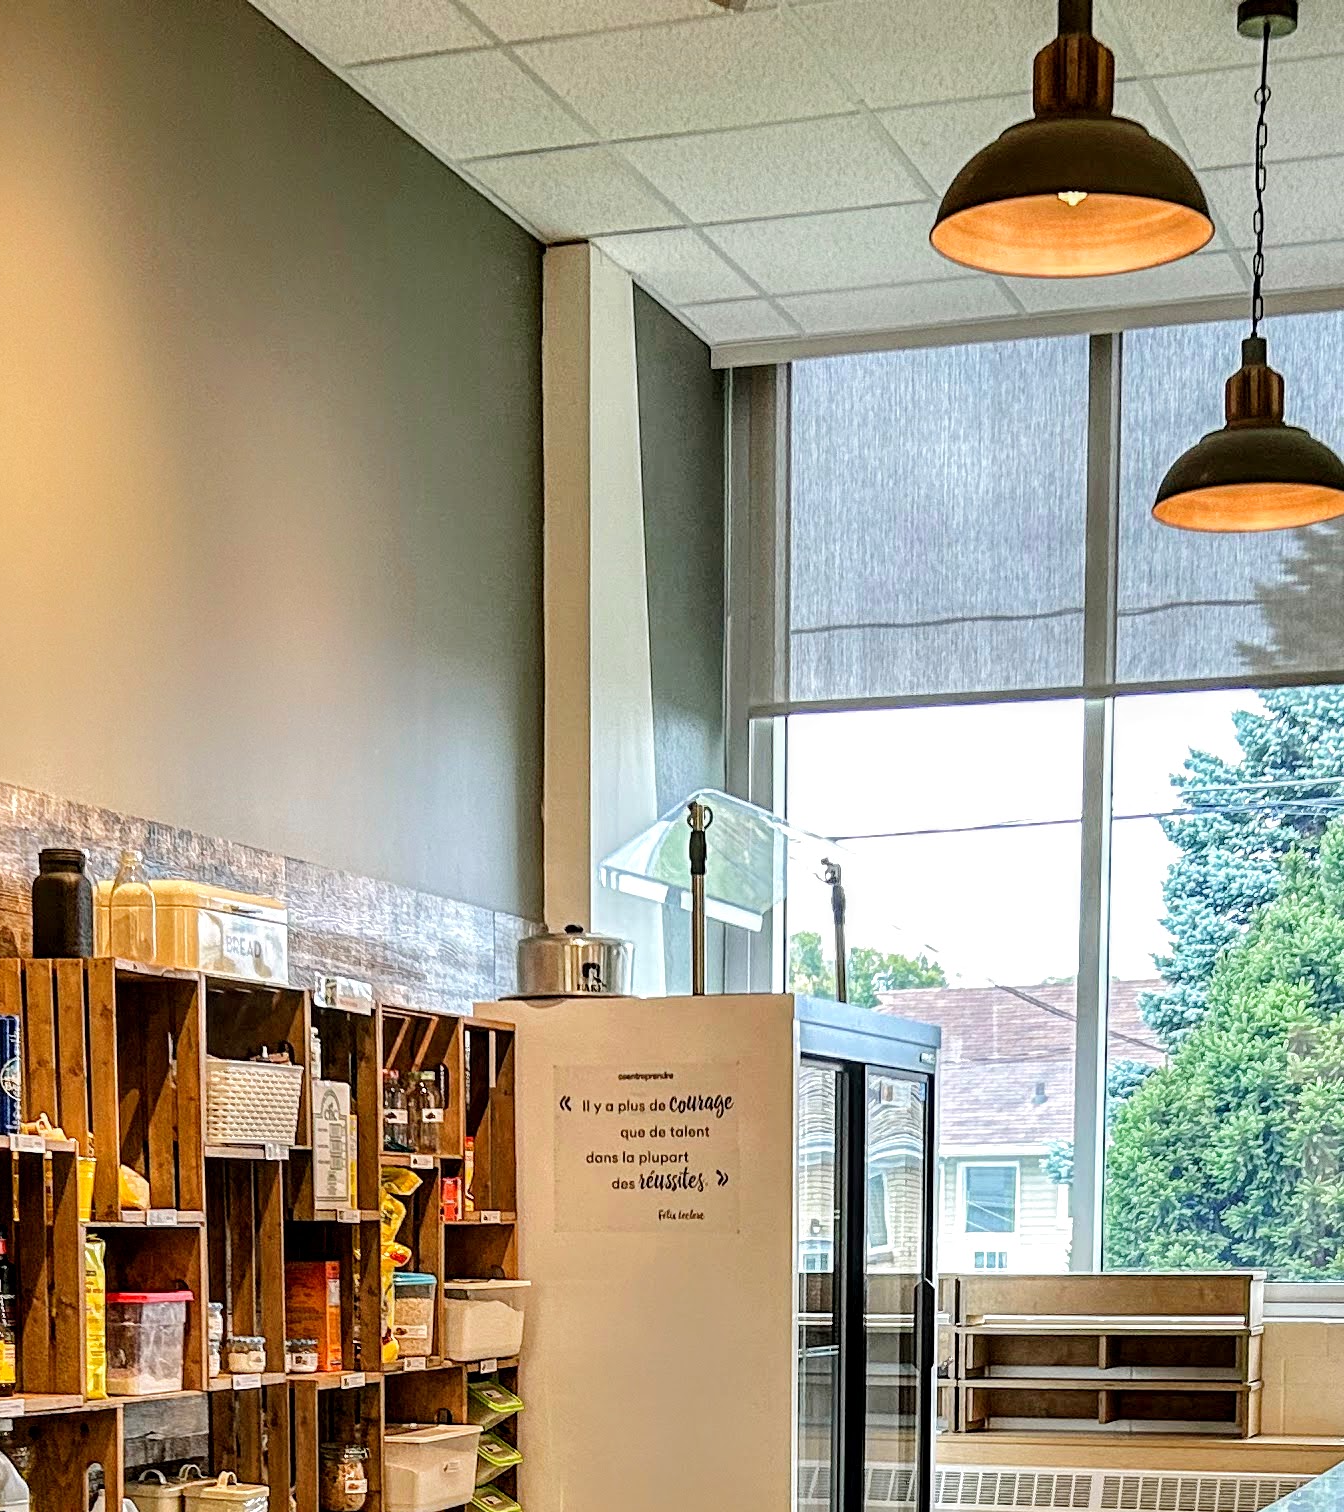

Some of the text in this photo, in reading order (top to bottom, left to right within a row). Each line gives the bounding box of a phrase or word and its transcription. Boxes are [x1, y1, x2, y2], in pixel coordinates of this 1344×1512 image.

[225, 935, 262, 958] BREAD
[594, 1101, 603, 1115] y
[605, 1102, 614, 1112] a
[618, 1099, 645, 1114] plus
[649, 1099, 666, 1112] de
[620, 1125, 710, 1141] que de talent
[586, 1151, 689, 1166] dans la plupart
[611, 1177, 636, 1190] des
